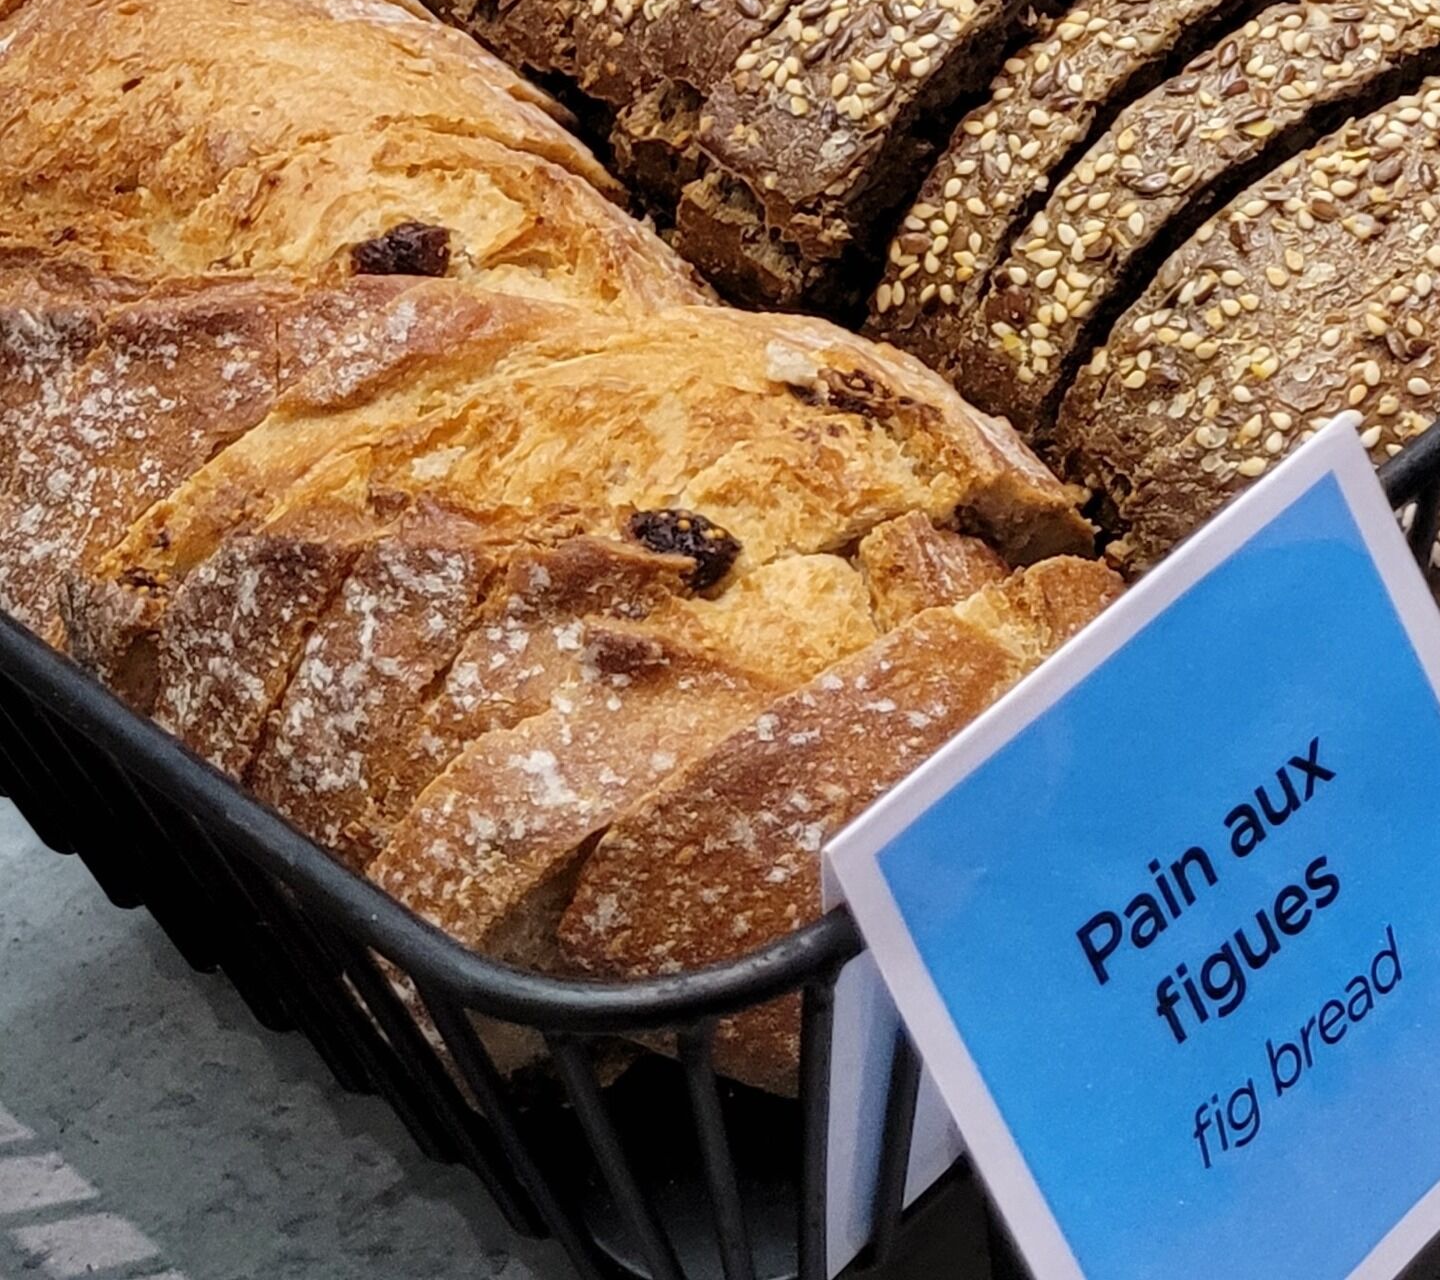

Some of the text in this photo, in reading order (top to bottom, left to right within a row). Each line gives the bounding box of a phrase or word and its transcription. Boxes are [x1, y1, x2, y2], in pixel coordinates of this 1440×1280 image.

[1075, 736, 1337, 987] Pain aux
[1155, 852, 1342, 1045] figues
[1193, 925, 1403, 1170] fig bread
